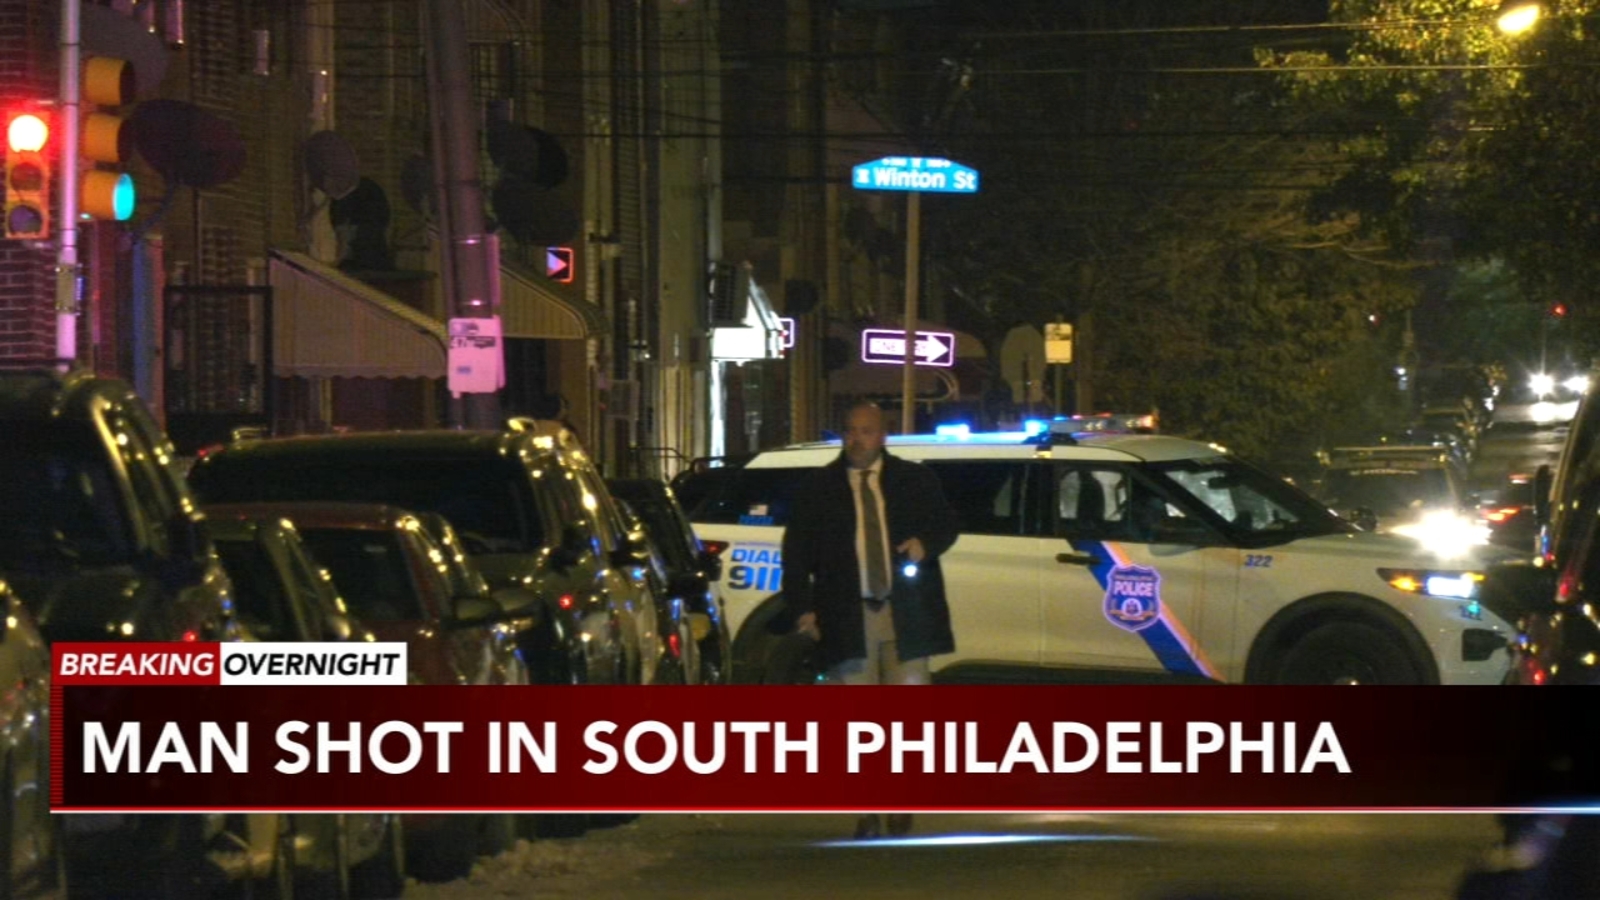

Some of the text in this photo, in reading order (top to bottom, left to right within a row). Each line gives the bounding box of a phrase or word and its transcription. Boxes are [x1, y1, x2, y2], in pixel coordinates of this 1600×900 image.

[874, 167, 945, 188] Winton
[954, 171, 975, 189] St
[731, 549, 782, 565] DIAL
[1245, 554, 1273, 567] 322
[728, 566, 783, 591] 911
[1113, 580, 1153, 597] POLICE
